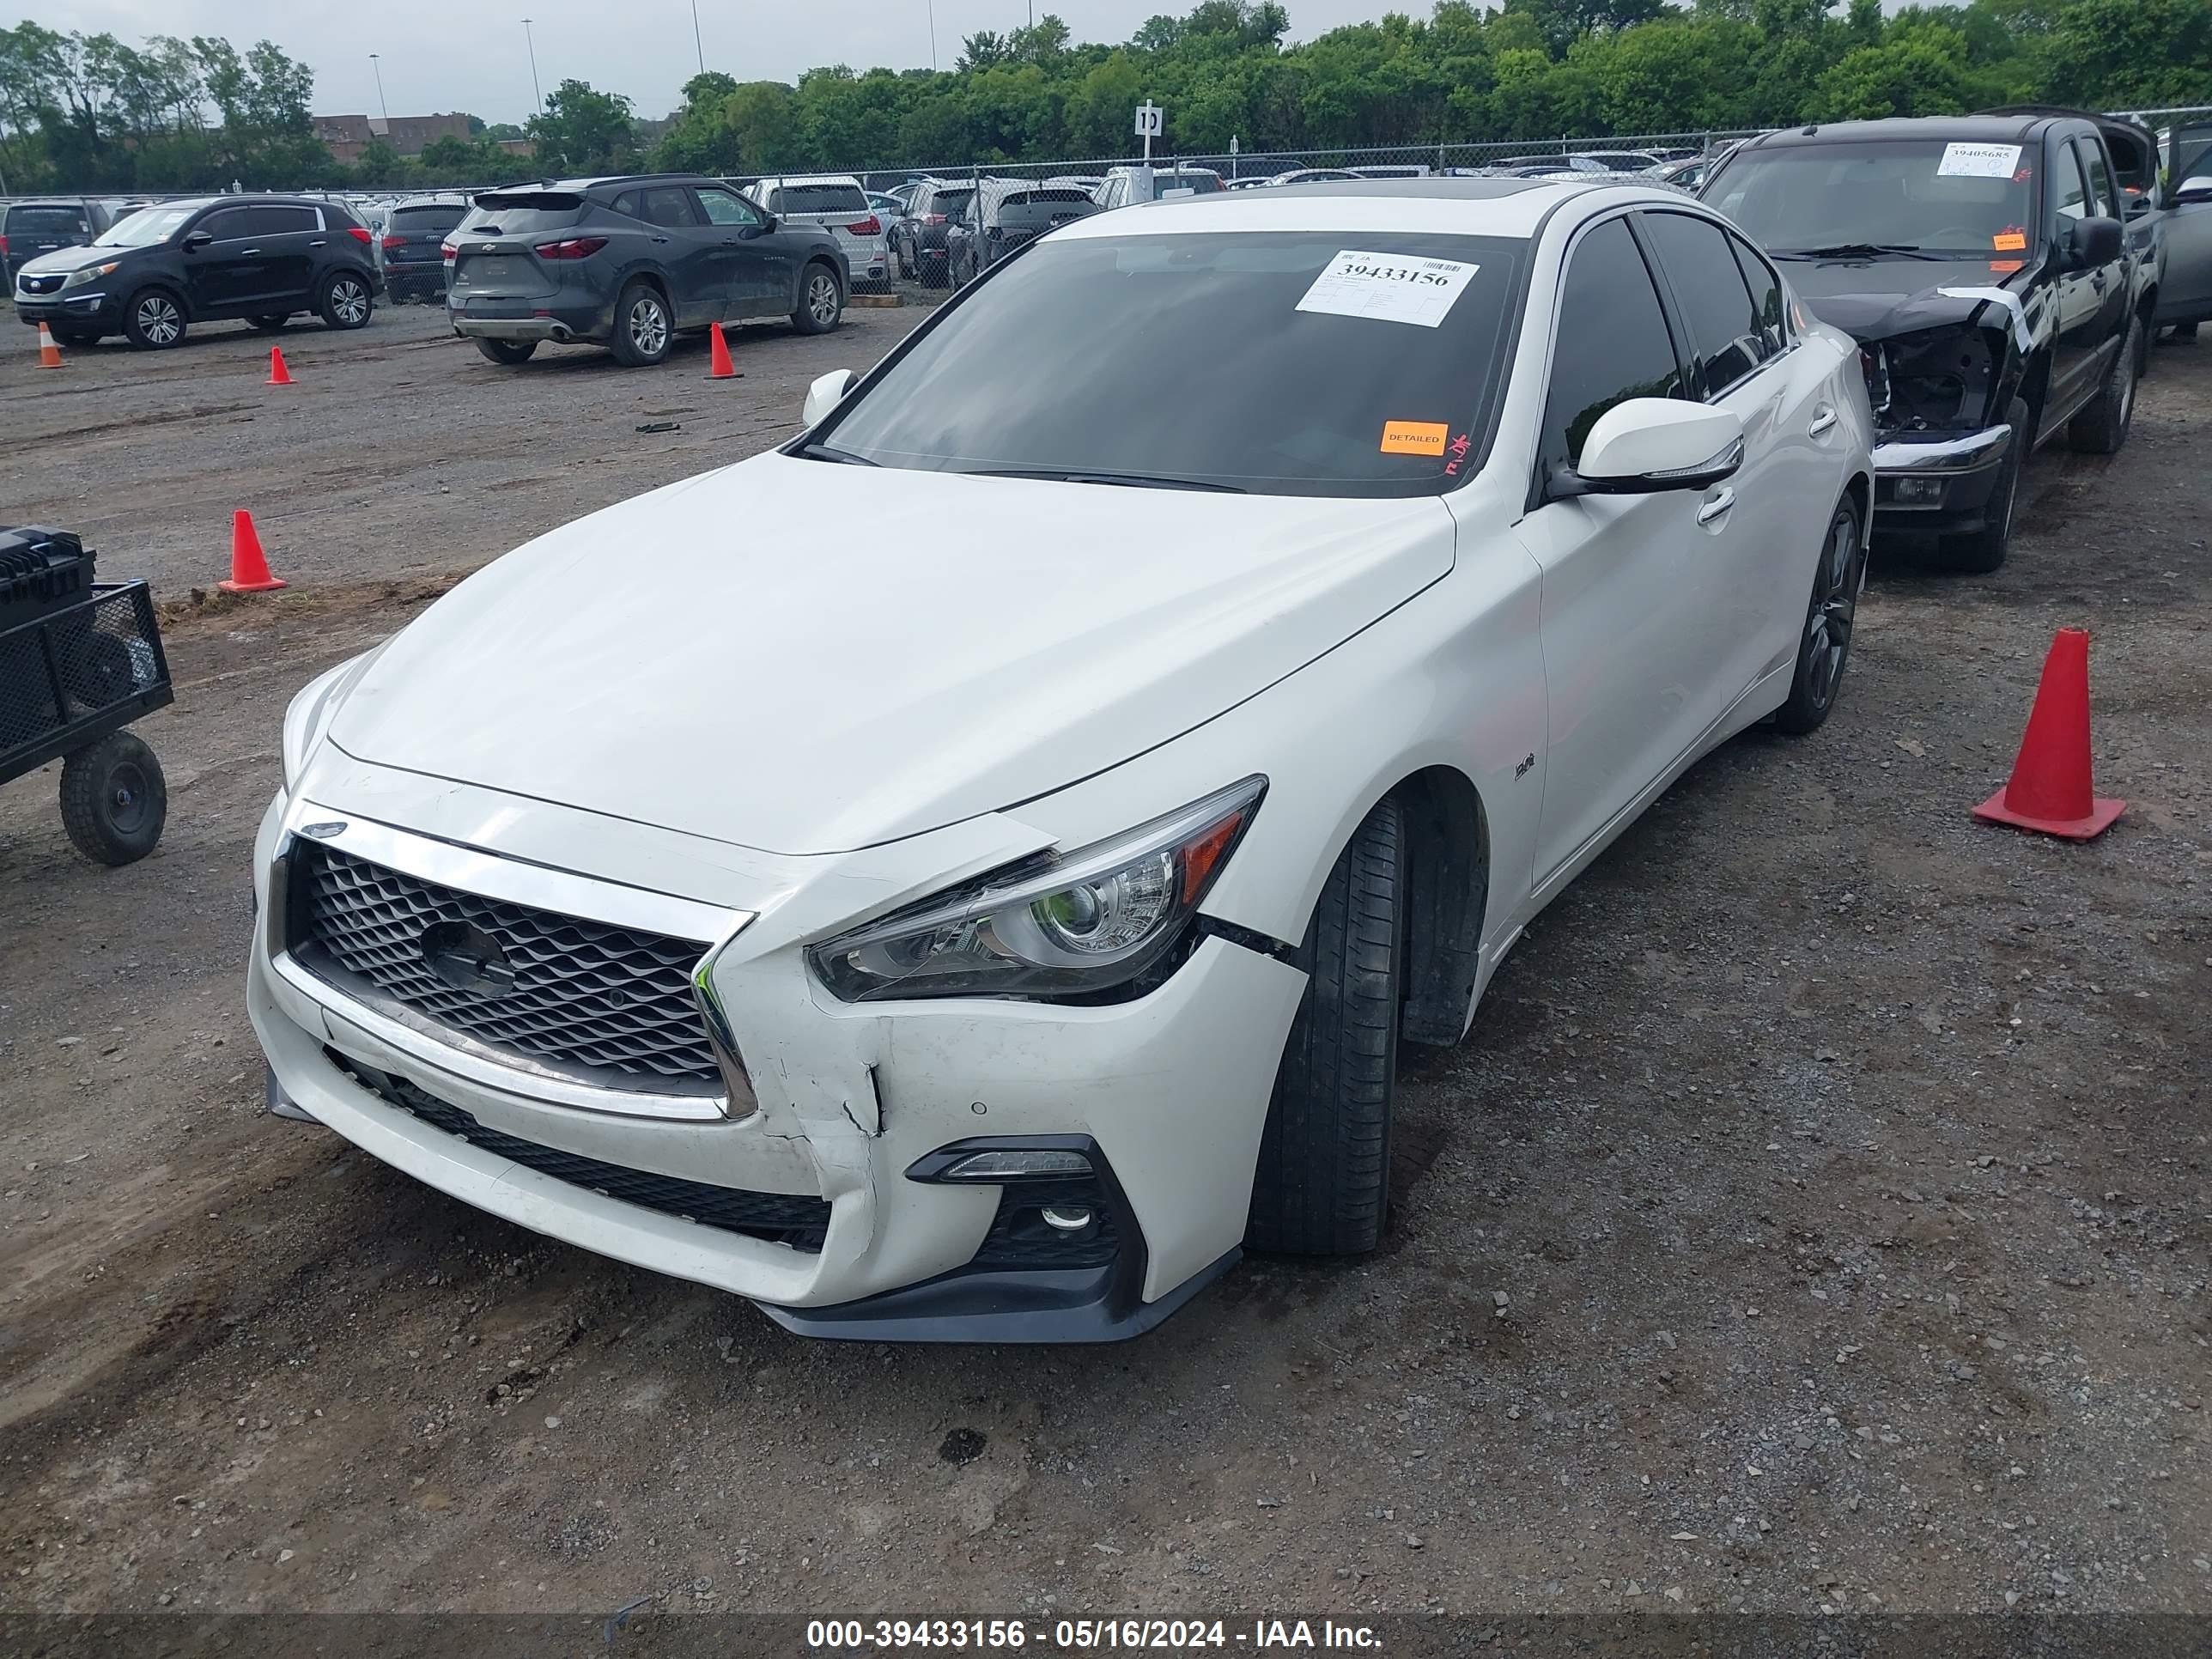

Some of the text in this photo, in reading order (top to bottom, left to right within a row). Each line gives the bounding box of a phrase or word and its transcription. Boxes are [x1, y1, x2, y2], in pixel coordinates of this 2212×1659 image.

[1951, 149, 2010, 159] 39405685
[1337, 264, 1453, 287] 39433156
[1389, 434, 1440, 443] DETAILED
